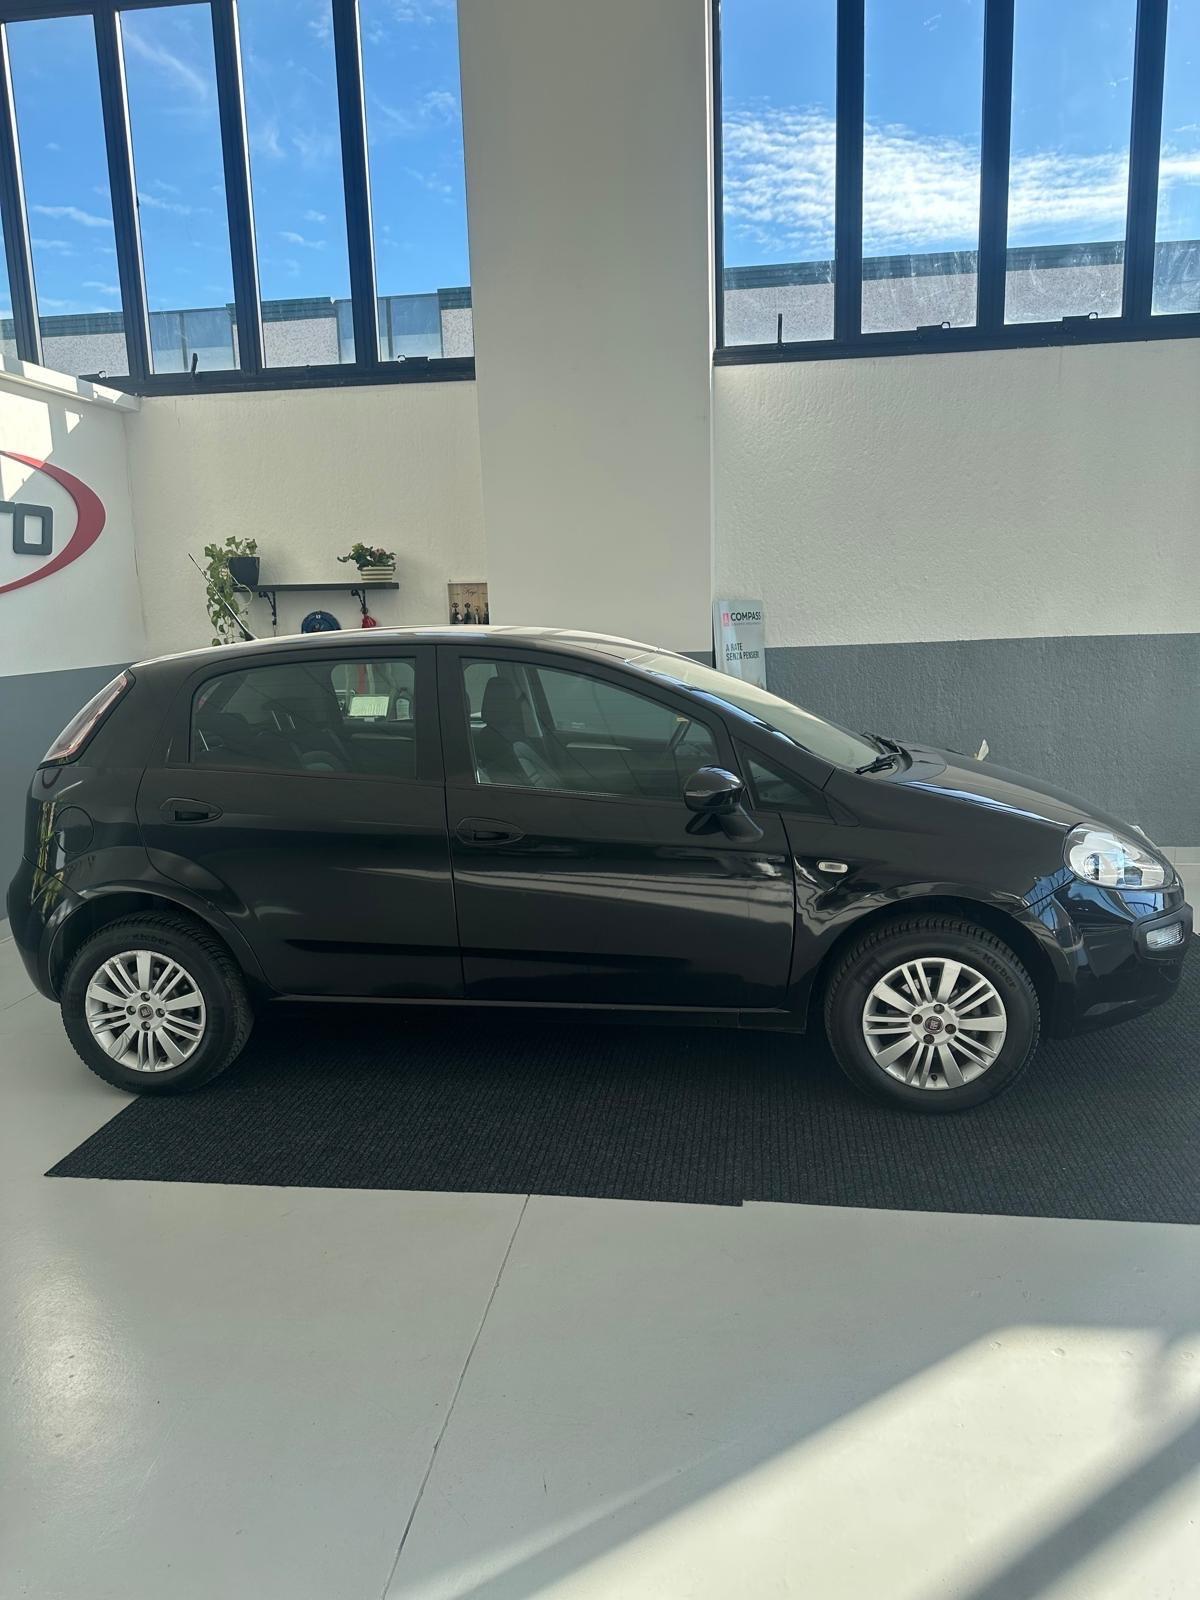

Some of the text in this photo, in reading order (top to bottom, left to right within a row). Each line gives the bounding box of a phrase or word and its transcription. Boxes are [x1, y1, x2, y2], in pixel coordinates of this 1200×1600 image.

[731, 611, 761, 621] COMPASS
[726, 651, 743, 661] SENZA
[982, 952, 1016, 988] Kleber
